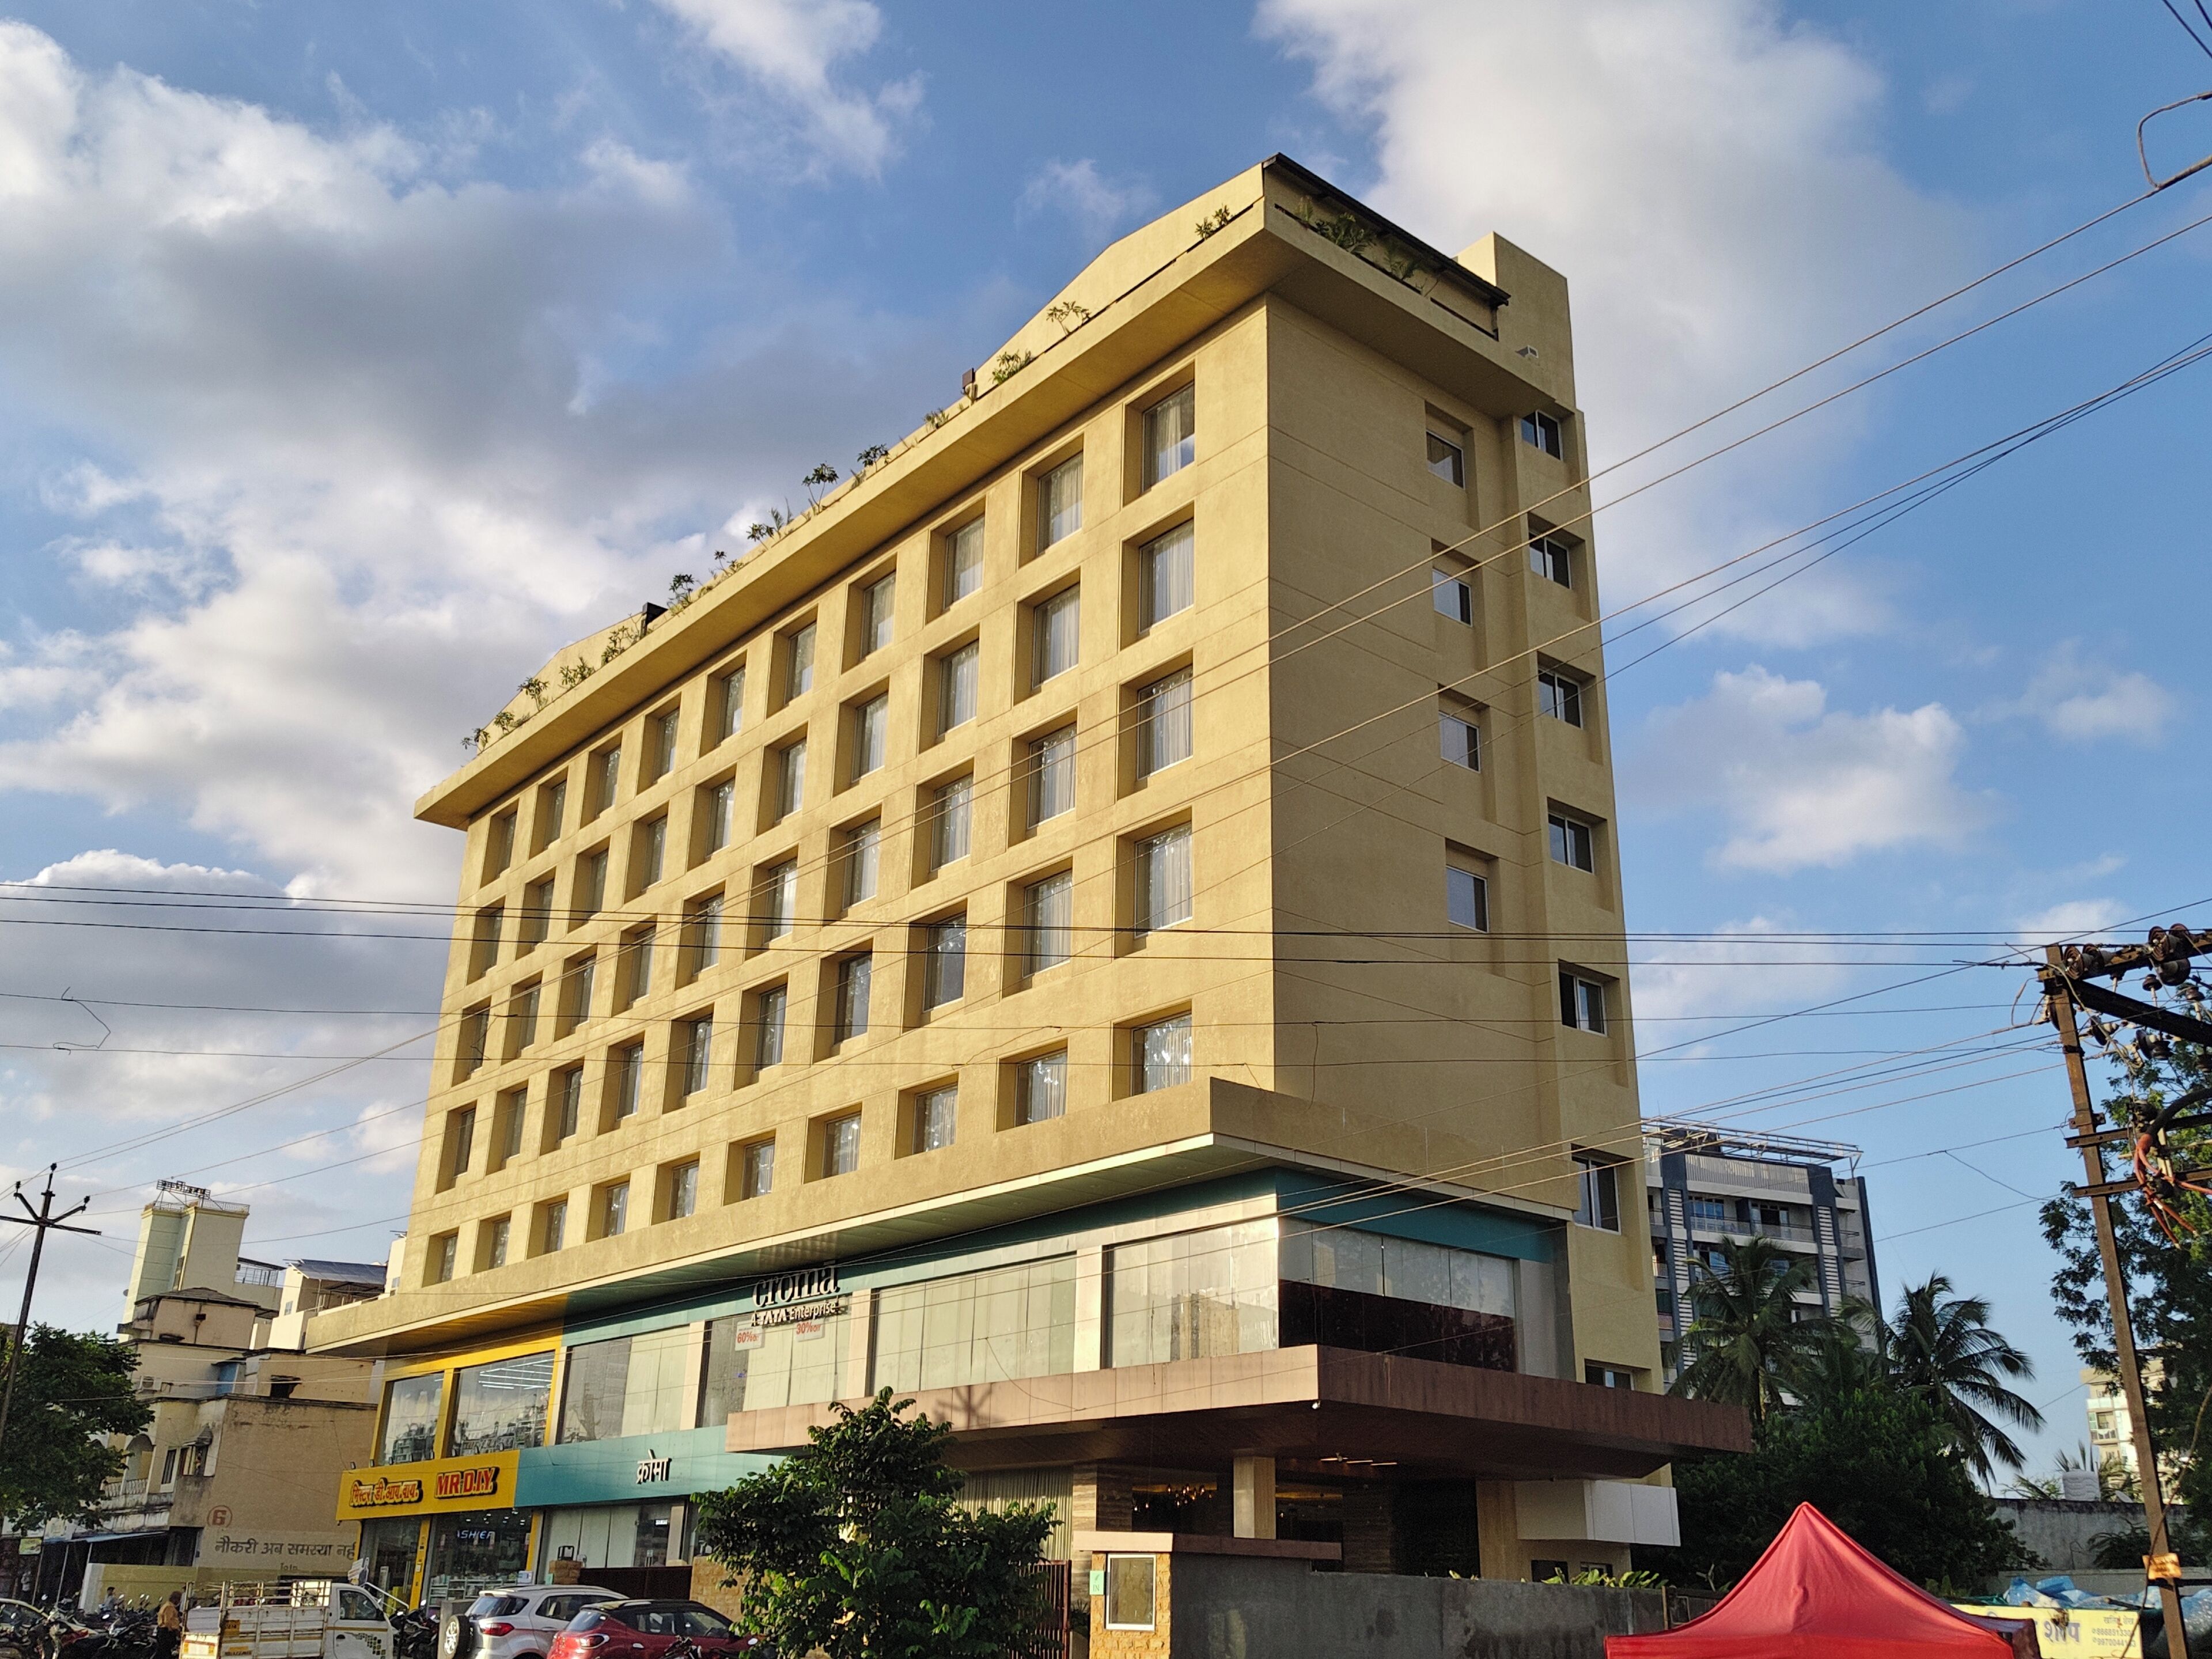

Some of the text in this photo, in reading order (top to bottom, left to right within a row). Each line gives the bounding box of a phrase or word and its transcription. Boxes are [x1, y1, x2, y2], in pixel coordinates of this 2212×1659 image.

[752, 1267, 838, 1308] croma
[751, 1301, 836, 1327] A TATA Enterprise
[636, 1449, 669, 1484] क्रोमा
[351, 1482, 372, 1504] मिस्टर
[215, 1535, 259, 1554] नौकरी
[261, 1542, 284, 1555] अब
[287, 1543, 334, 1556] समस्या
